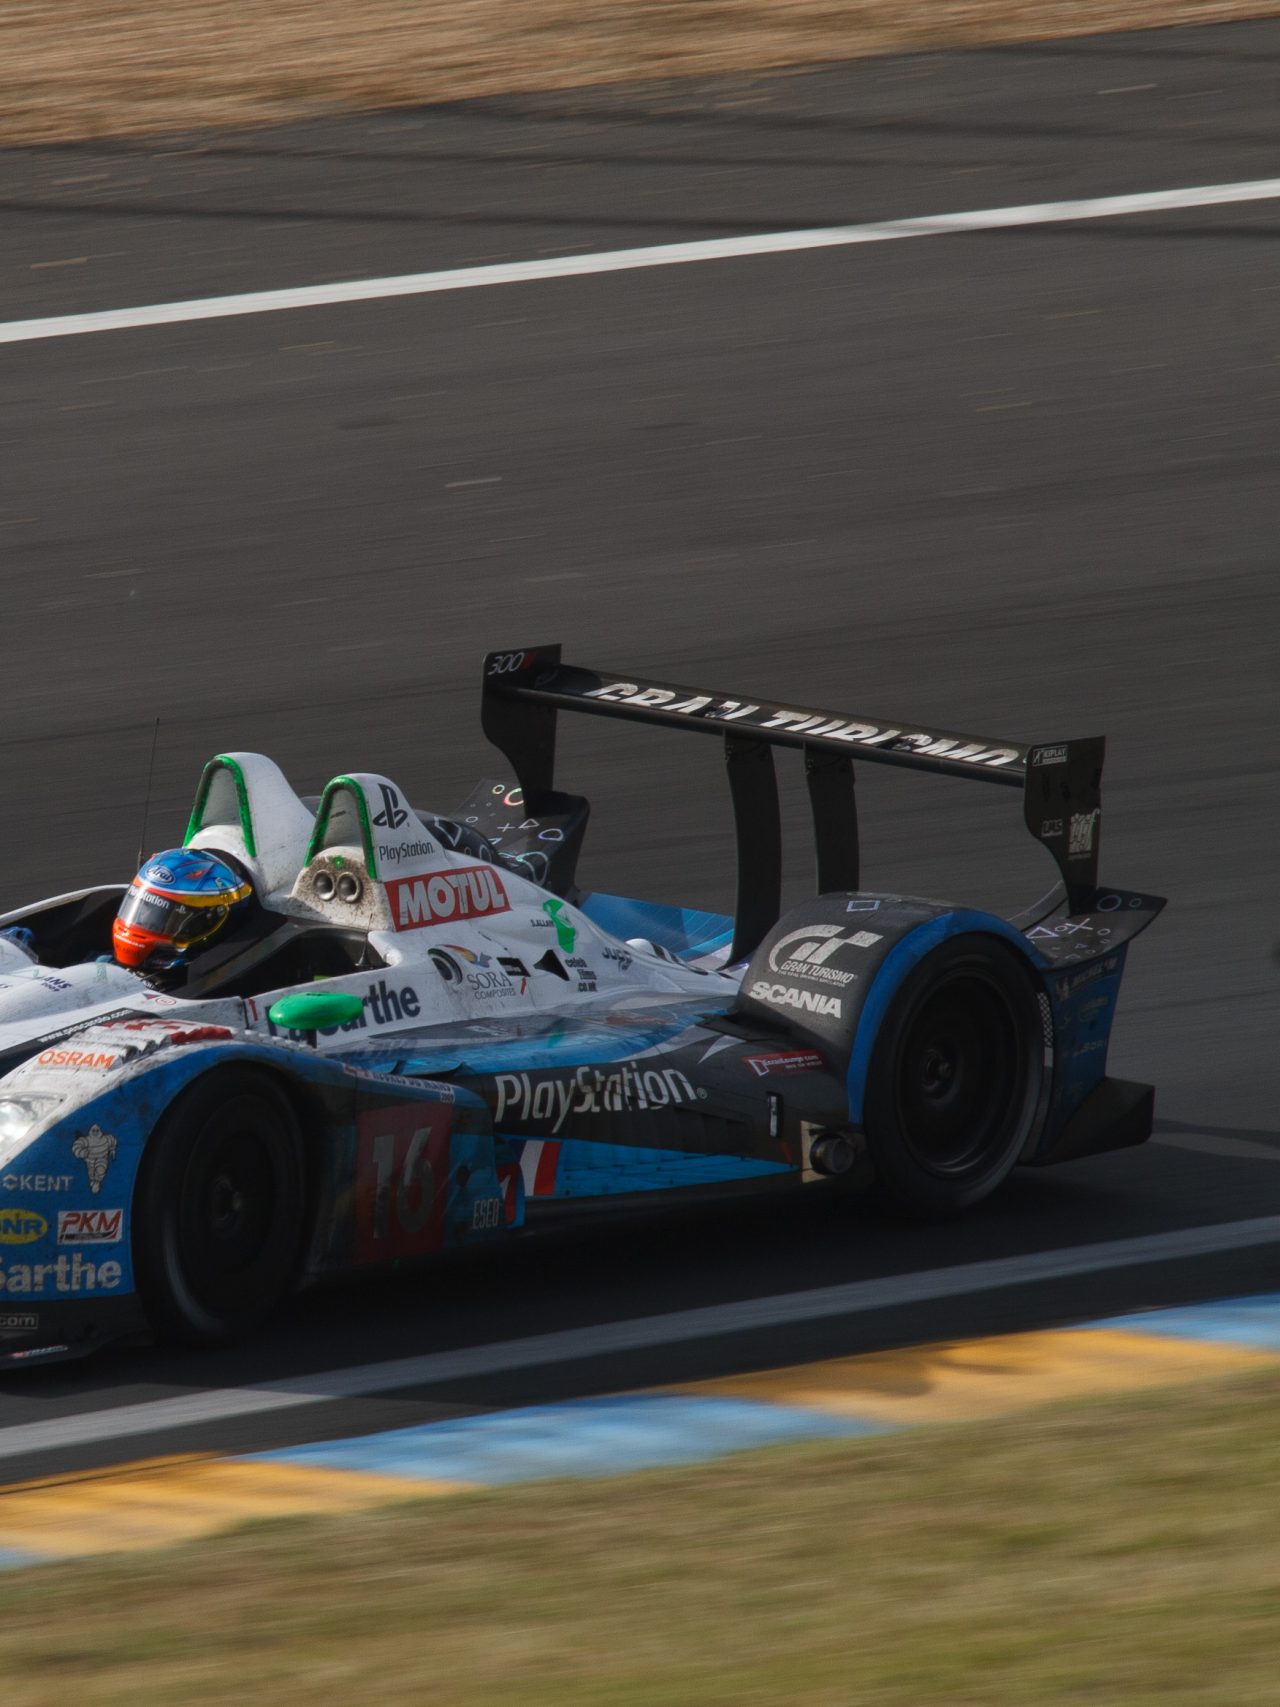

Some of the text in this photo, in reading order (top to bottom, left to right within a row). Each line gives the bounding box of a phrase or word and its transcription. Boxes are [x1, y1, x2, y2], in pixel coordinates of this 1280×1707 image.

[487, 652, 526, 676] 300
[379, 839, 434, 865] PlayStation
[148, 866, 174, 882] Arai
[397, 869, 506, 926] MOTUL
[466, 970, 513, 991] SORA
[780, 959, 855, 984] GRAN TURISMO
[474, 986, 517, 1001] COMPOSITES
[750, 981, 842, 1019] SCANIA
[38, 1049, 117, 1070] OSRAM
[494, 1061, 697, 1134] PlayStation
[20, 1174, 75, 1192] KENT
[372, 1125, 435, 1240] 16
[61, 1211, 122, 1233] PKM
